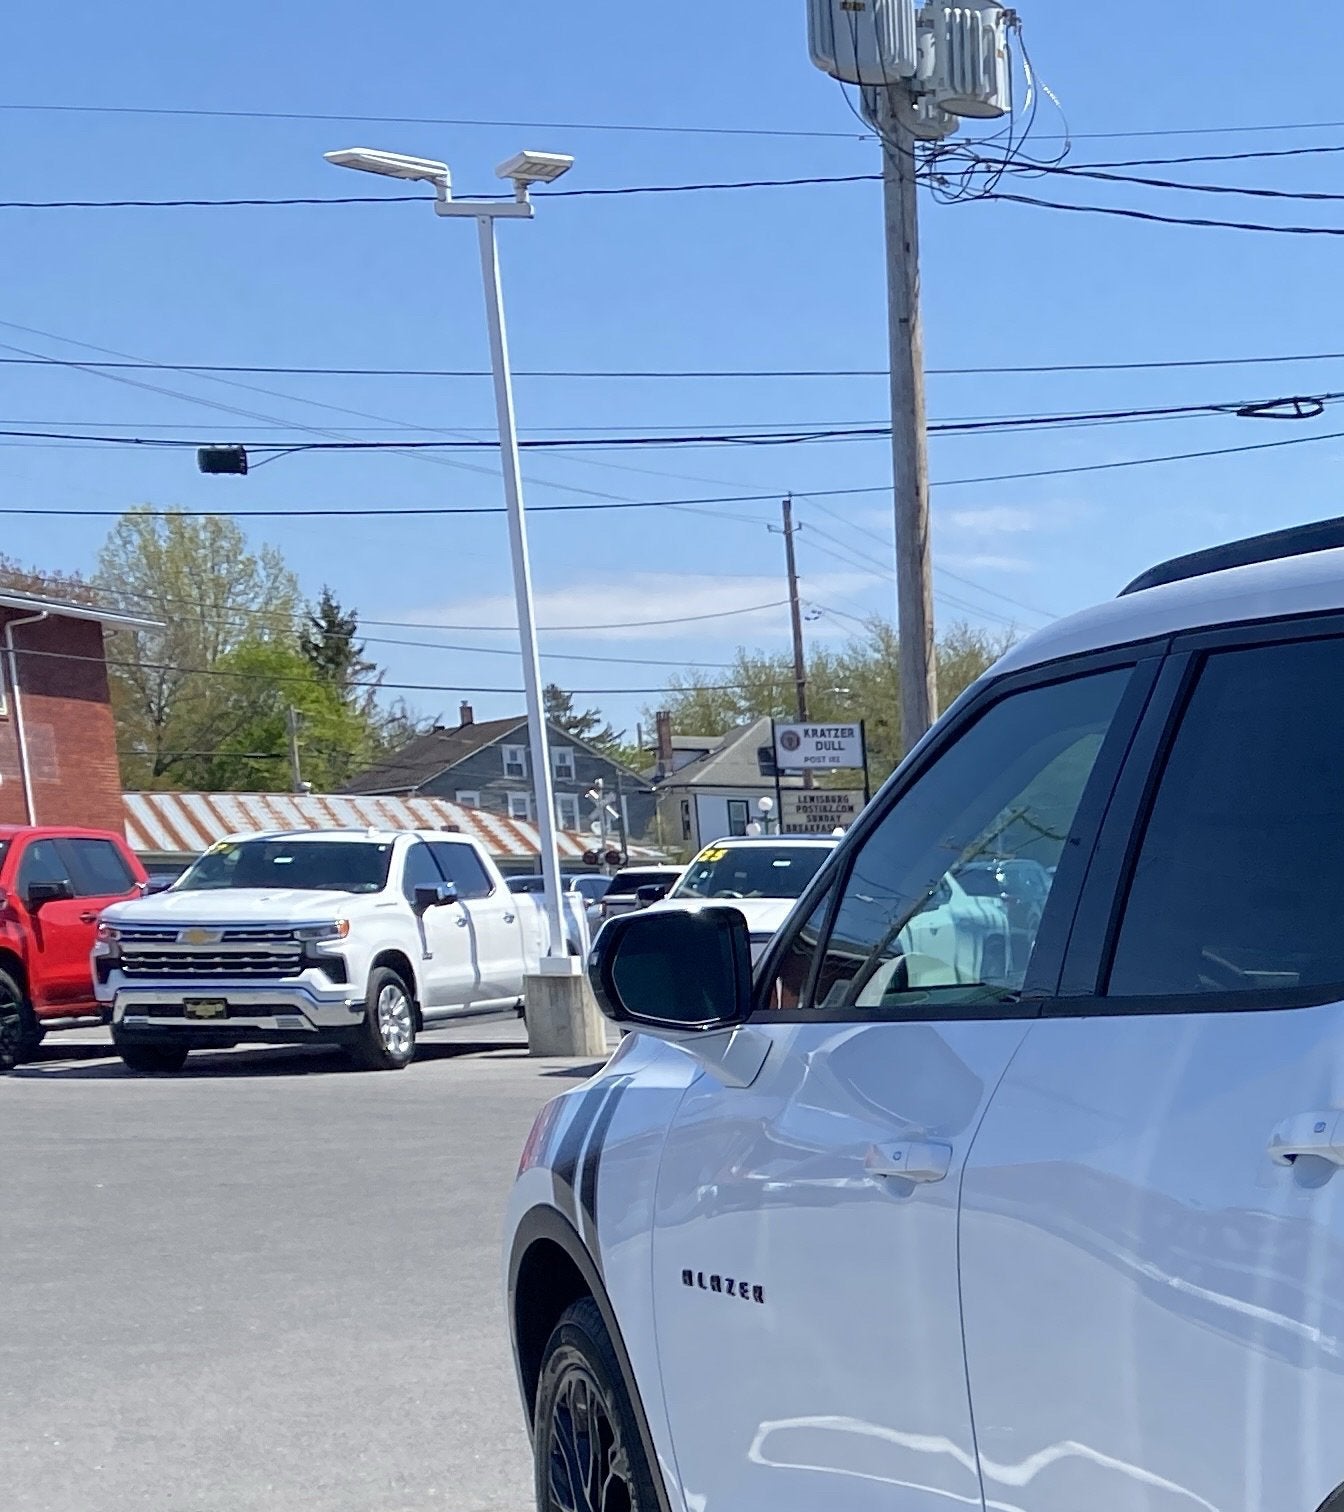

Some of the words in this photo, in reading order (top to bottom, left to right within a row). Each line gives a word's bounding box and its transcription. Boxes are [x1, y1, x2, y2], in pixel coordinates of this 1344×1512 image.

[803, 727, 855, 739] KRATZER
[815, 740, 846, 751] DULL
[806, 814, 842, 823] SUNDAY
[681, 1268, 765, 1304] BLAZER
